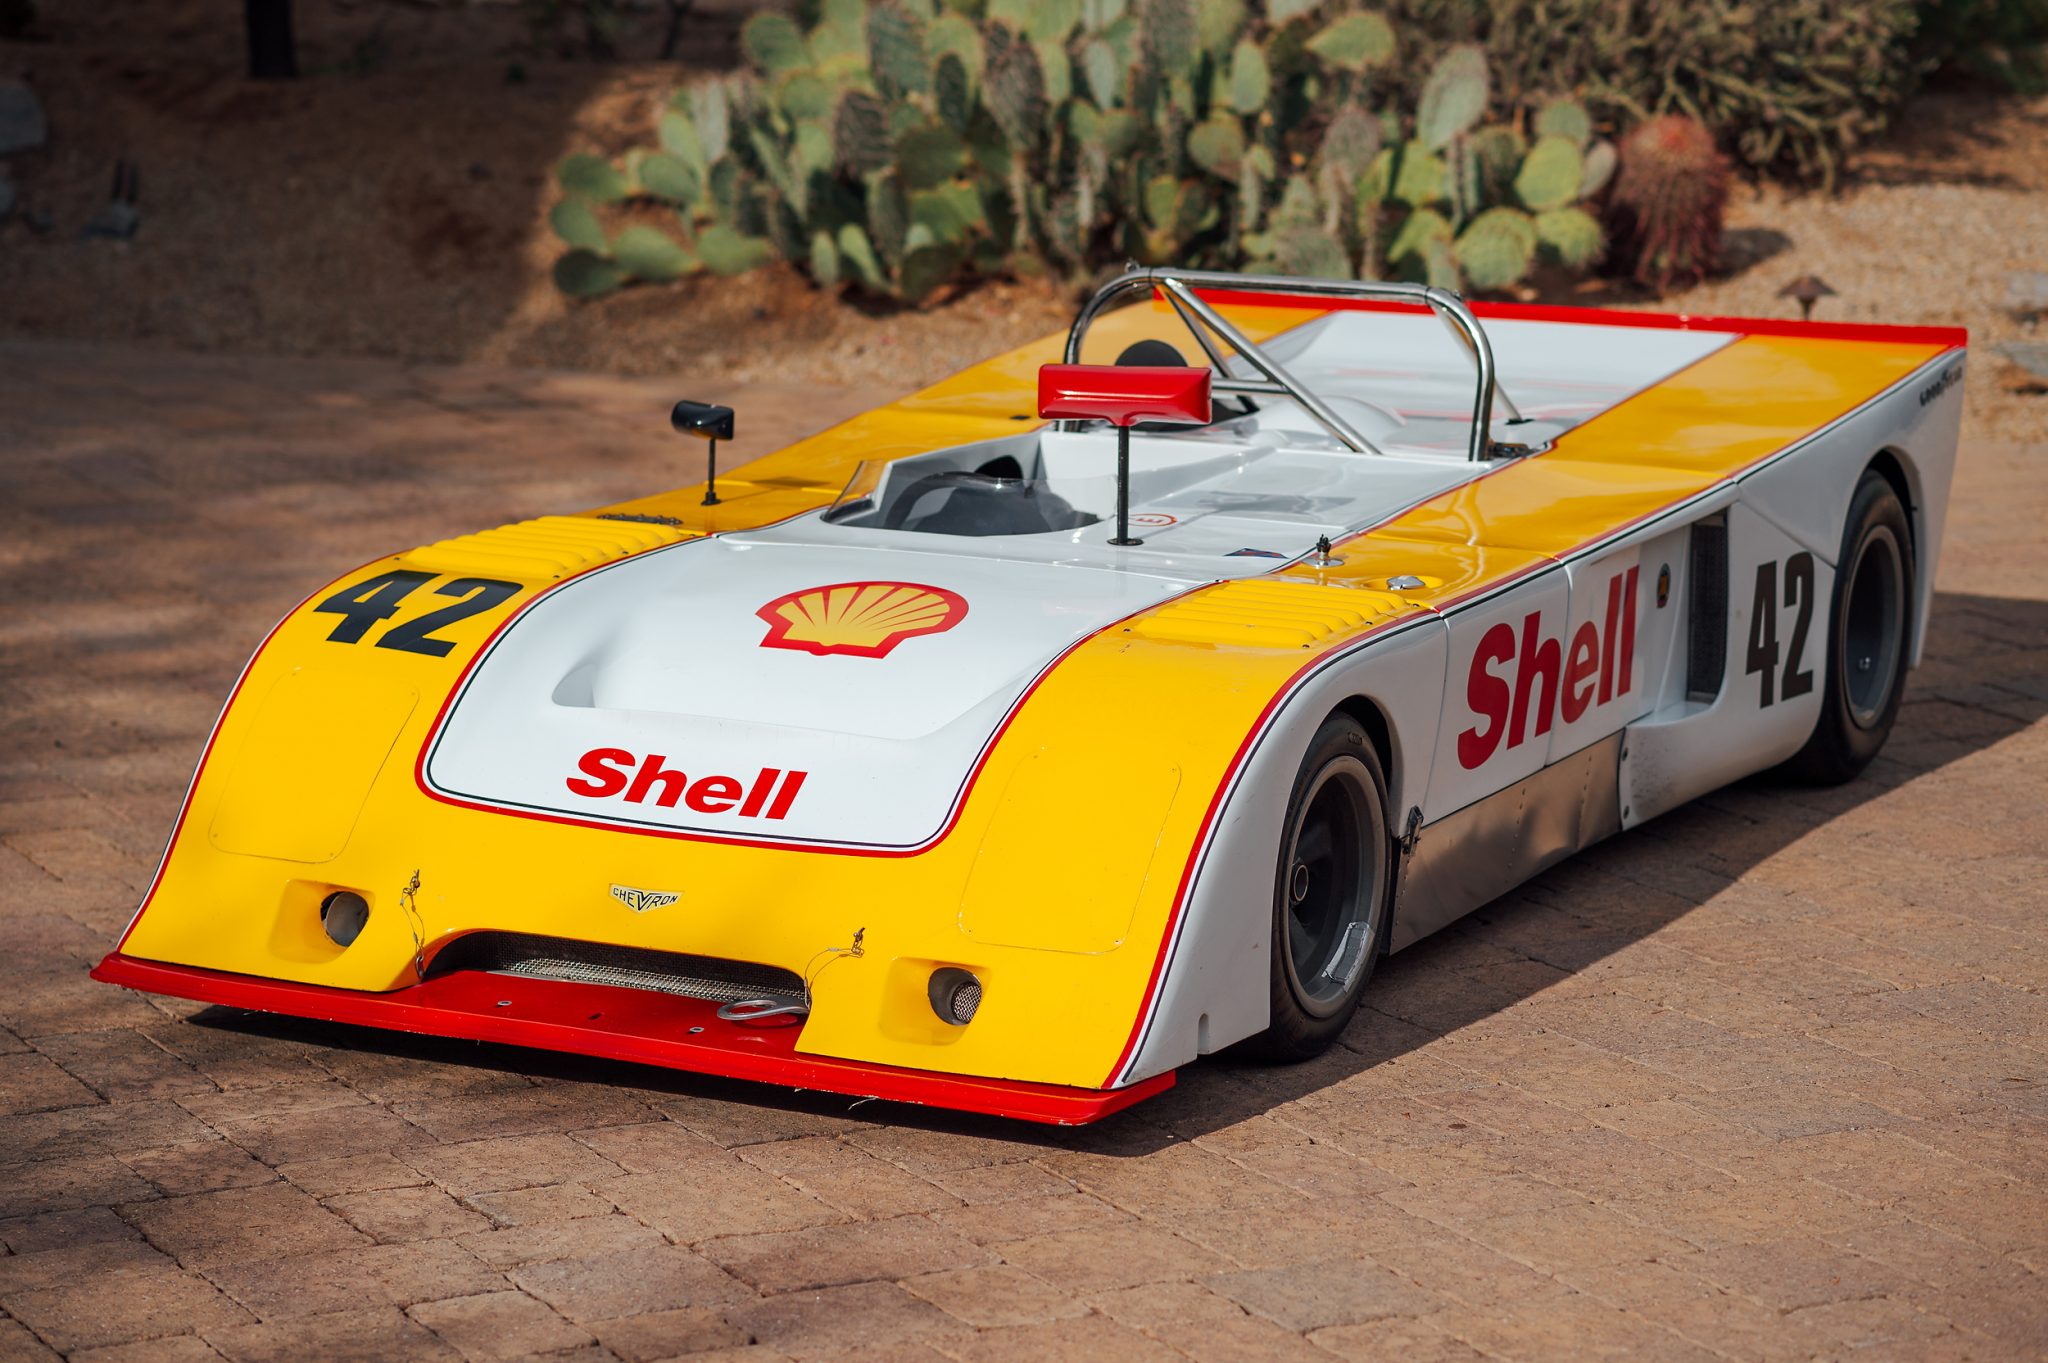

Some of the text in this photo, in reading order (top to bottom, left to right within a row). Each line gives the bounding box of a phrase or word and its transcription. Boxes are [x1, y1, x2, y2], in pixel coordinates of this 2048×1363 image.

[312, 569, 524, 658] 42
[1745, 552, 1815, 709] 42
[1457, 564, 1640, 770] Shell
[566, 748, 808, 820] Shell
[613, 887, 678, 911] CHEVRON
